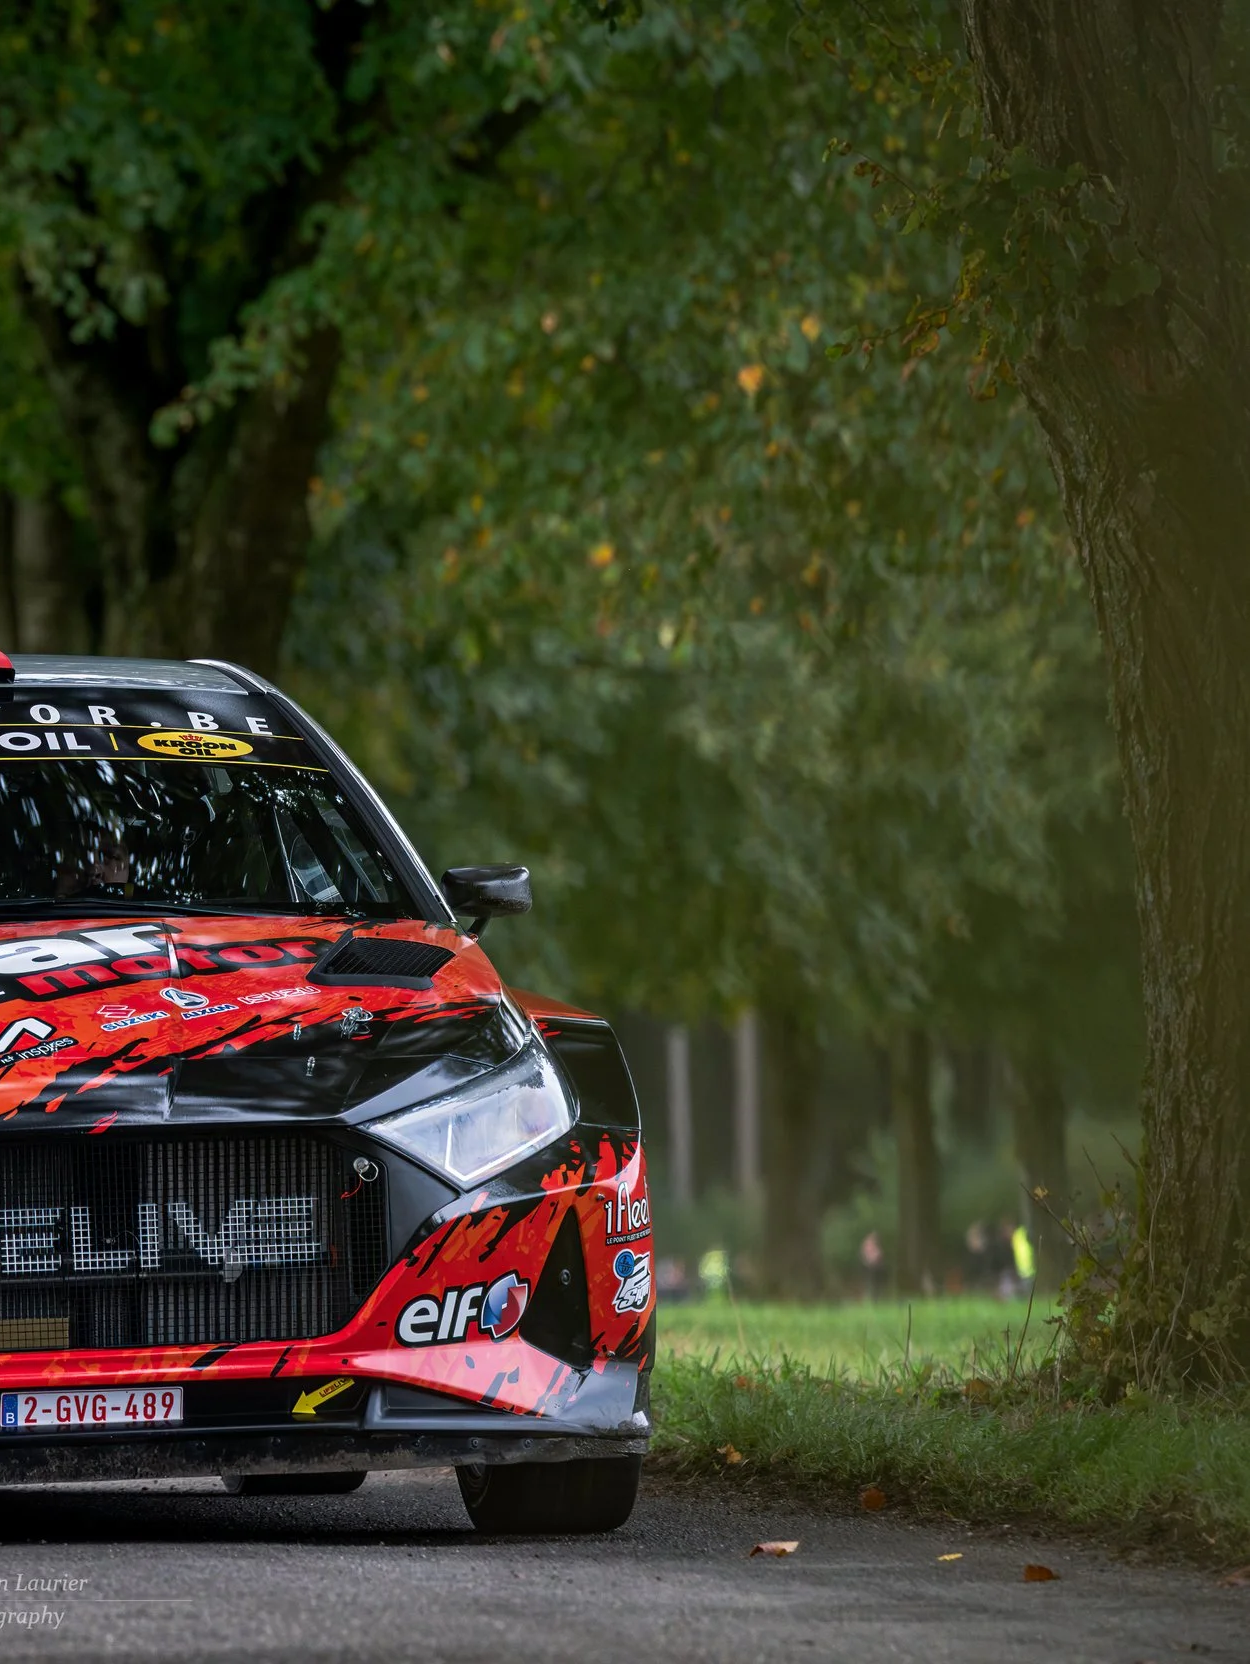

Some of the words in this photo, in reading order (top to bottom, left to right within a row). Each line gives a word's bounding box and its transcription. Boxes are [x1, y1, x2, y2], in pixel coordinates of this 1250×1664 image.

[153, 739, 237, 751] KROON
[180, 746, 216, 757] OIL
[17, 937, 320, 996] motor
[238, 986, 321, 1005] ISUZU
[101, 1011, 170, 1031] SUZUKI
[182, 1004, 237, 1019] AIXAM
[16, 1037, 75, 1060] inspires
[398, 1286, 484, 1343] elf
[5, 1412, 15, 1424] B
[23, 1391, 175, 1424] 2-GVG-489
